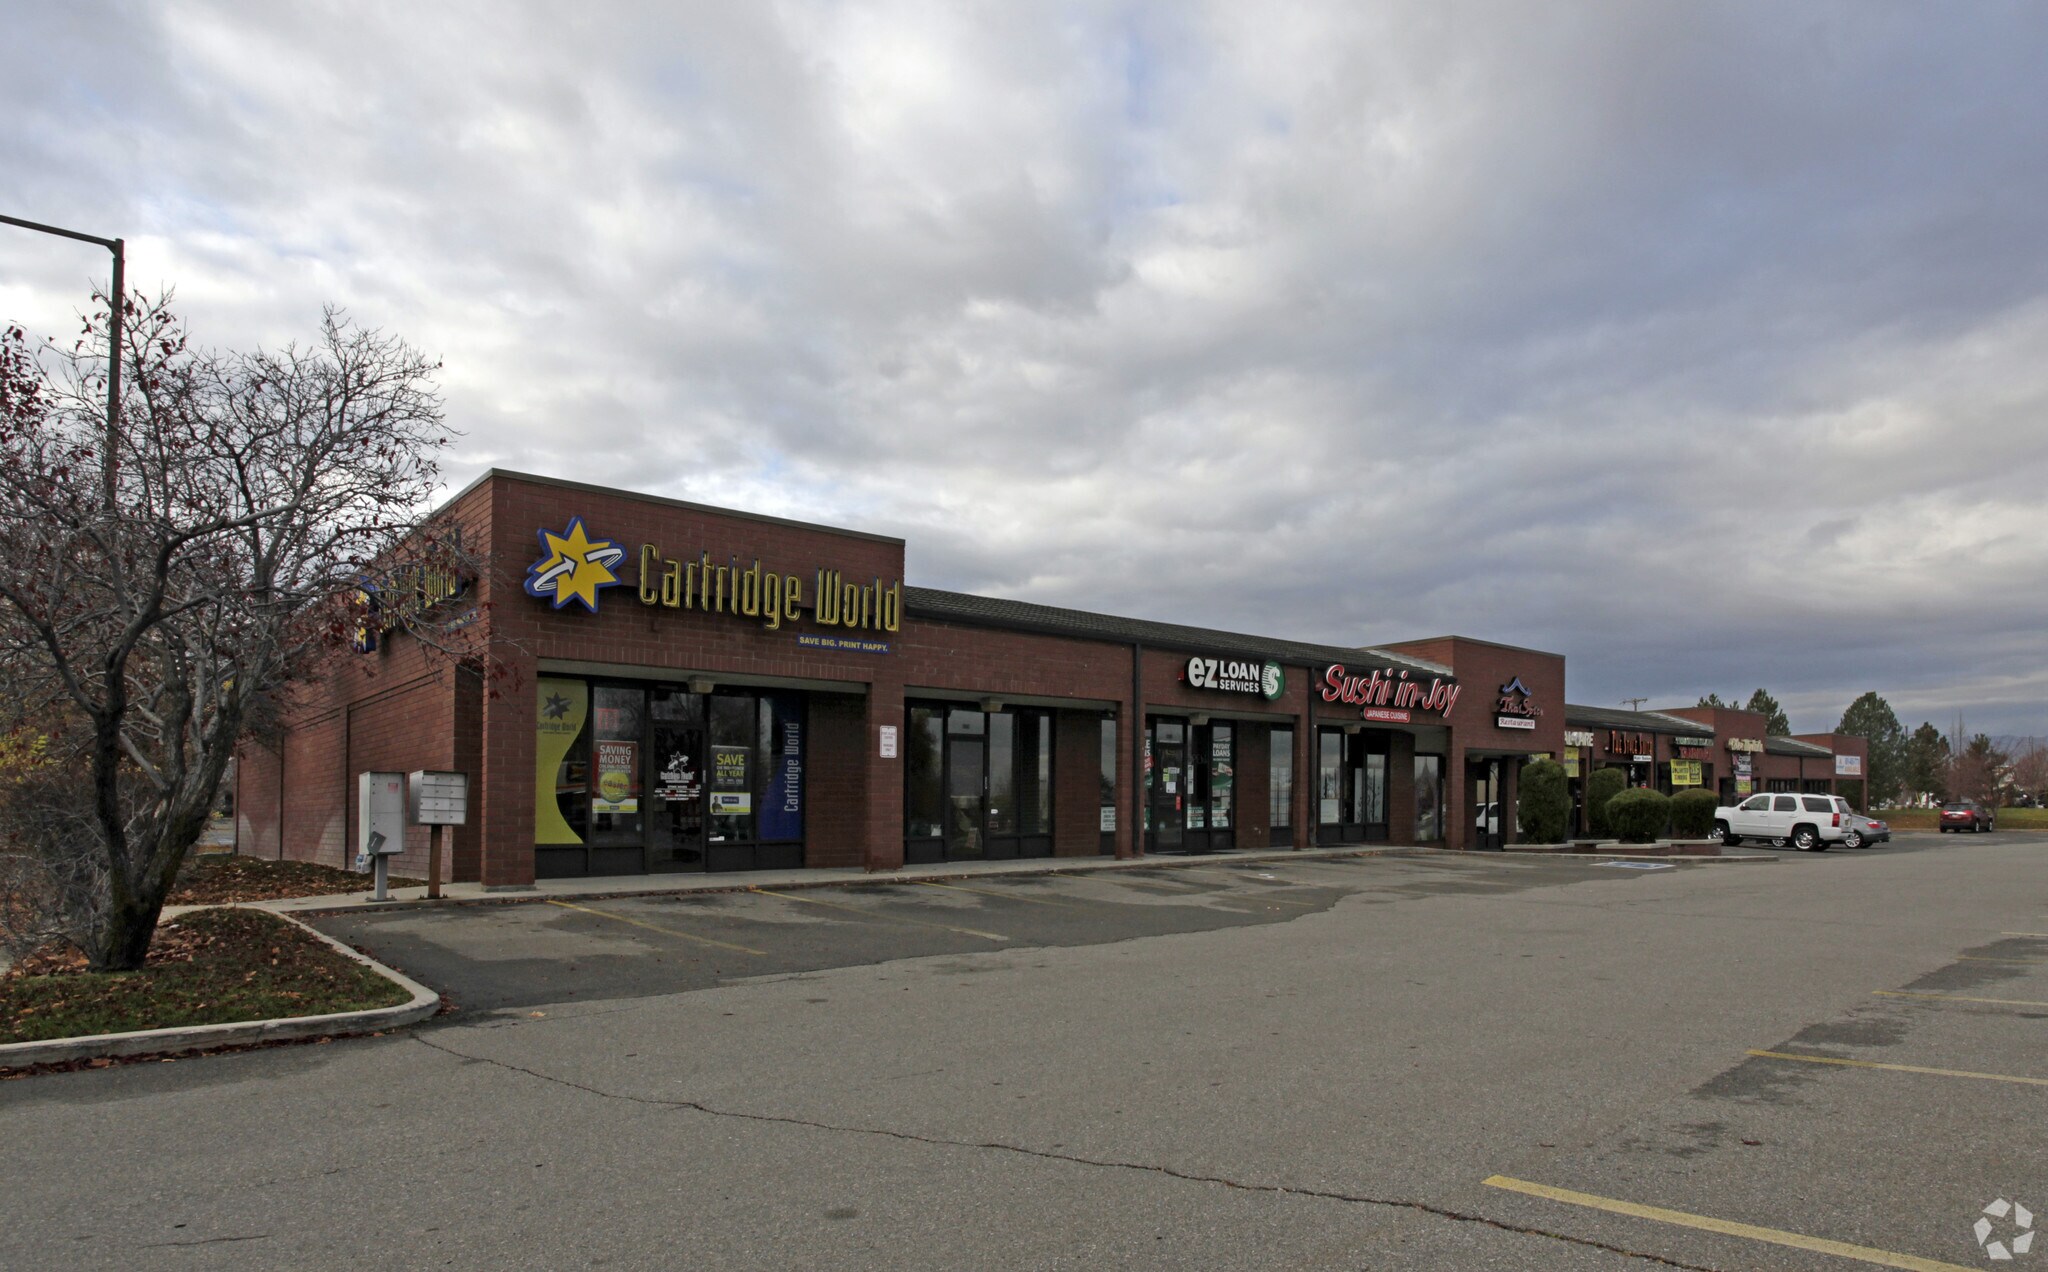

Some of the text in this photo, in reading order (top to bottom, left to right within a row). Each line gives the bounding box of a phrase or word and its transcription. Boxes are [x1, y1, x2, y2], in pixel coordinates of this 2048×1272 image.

[639, 543, 900, 633] Cartridge World
[799, 636, 888, 652] SAVE BIG. PRINT HAPPY.
[1220, 660, 1260, 681] LOAN
[1219, 679, 1260, 693] SERVICES
[1322, 664, 1461, 718] Sushi in Joy
[1366, 710, 1408, 720] JAPANESE CUISINE
[1500, 718, 1535, 728] Restaurant
[600, 745, 632, 755] SAVING
[1212, 749, 1231, 757] LOANS
[600, 754, 631, 765] MONEY
[716, 753, 745, 766] SAVE
[784, 723, 802, 812] Cartridge World
